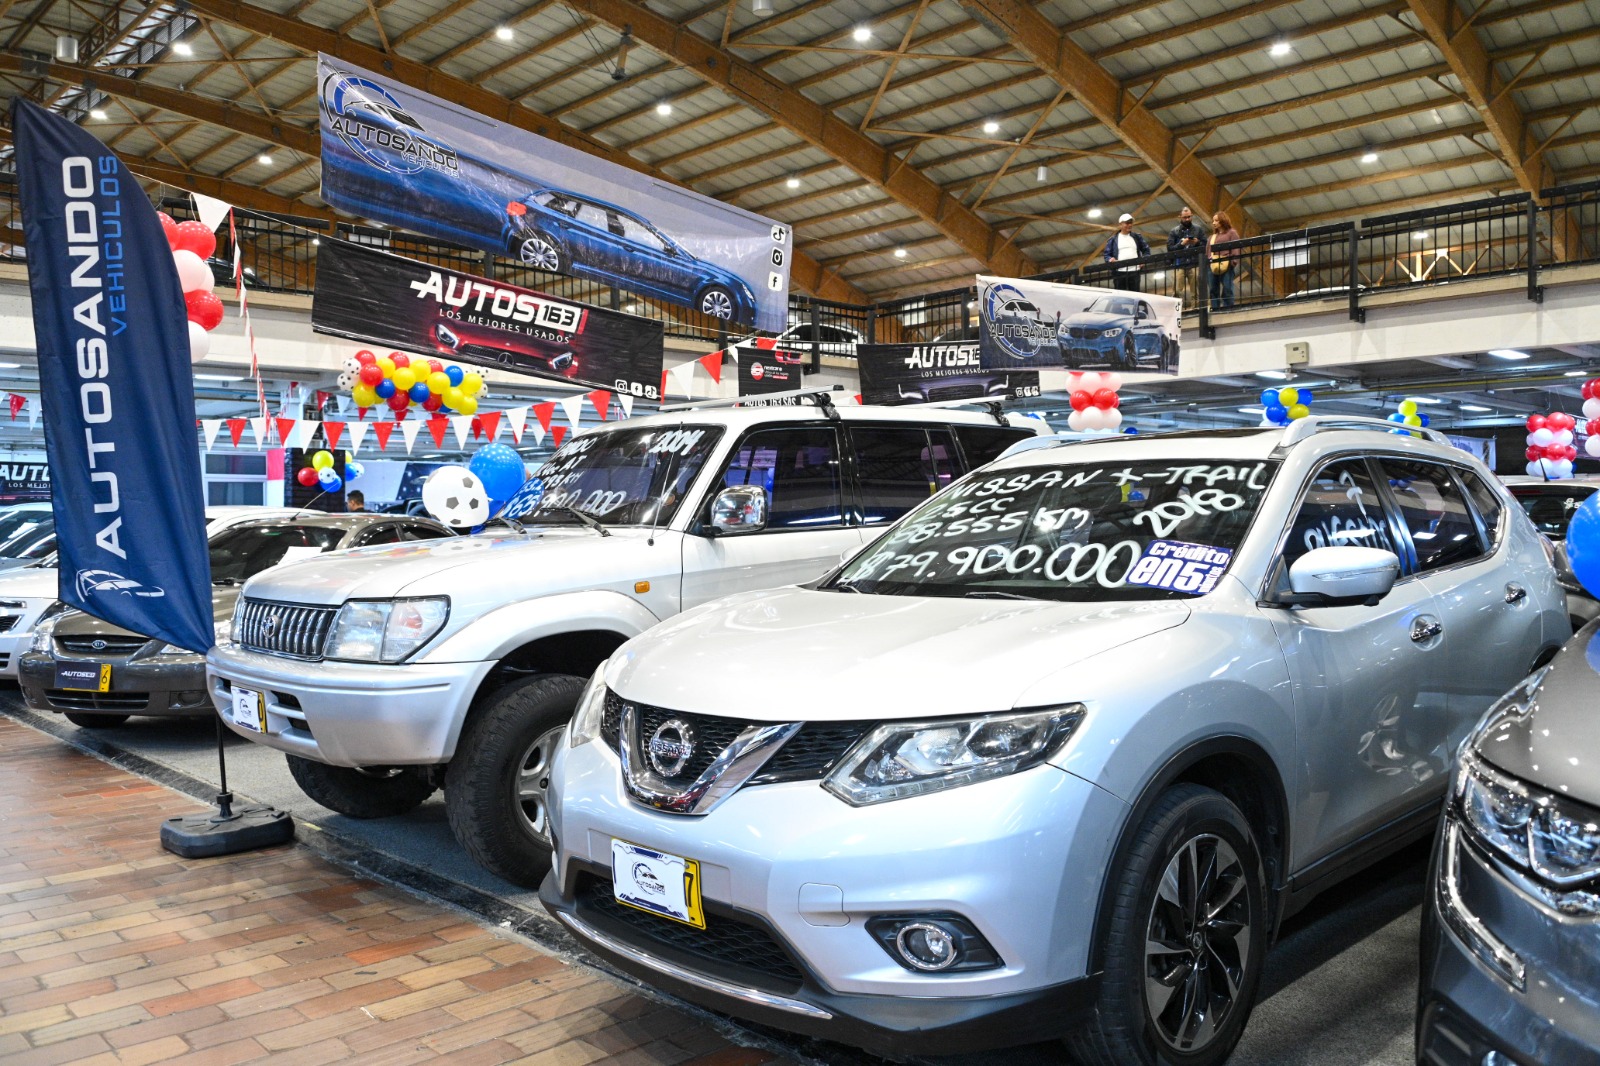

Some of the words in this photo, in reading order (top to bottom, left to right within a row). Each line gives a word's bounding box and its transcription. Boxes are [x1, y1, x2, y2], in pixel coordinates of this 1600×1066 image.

[331, 118, 459, 171] AUTOSANDO
[401, 152, 459, 178] VEHICULOS
[98, 155, 127, 337] VEHICULOS
[439, 309, 461, 321] LOS
[467, 314, 520, 333] MEJORES
[526, 328, 570, 344] USADOS
[990, 322, 1056, 340] AUTOSANDO
[62, 156, 127, 561] AUTOSANDO
[650, 429, 705, 456] 2004
[951, 469, 1103, 499] NISSAN
[1109, 462, 1267, 490] X-TRAIL
[1132, 488, 1246, 539] 2018
[1149, 542, 1230, 566] Crédito
